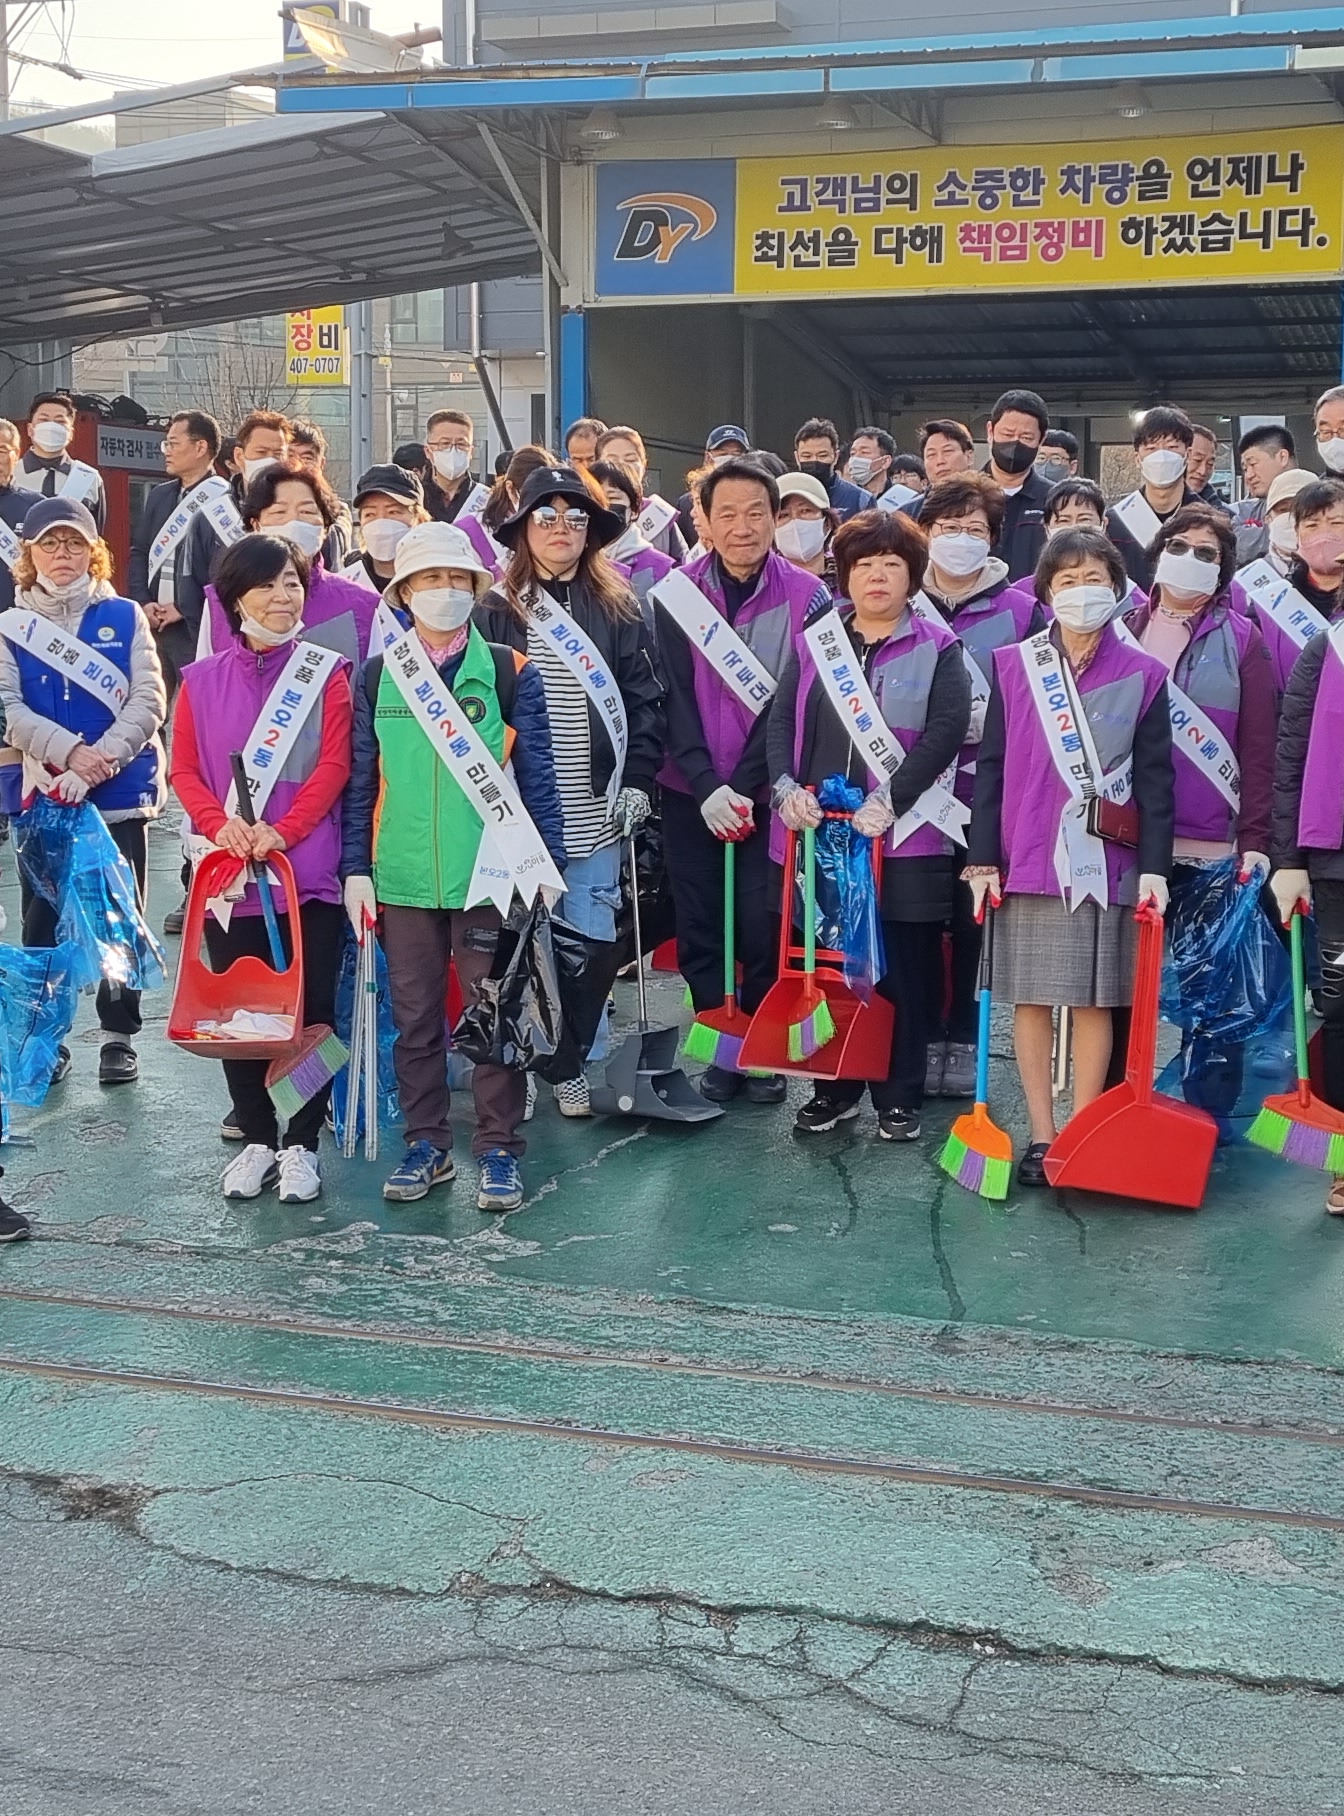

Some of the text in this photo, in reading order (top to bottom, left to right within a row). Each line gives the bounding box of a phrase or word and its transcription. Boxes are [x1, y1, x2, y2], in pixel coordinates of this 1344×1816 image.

[777, 152, 1306, 215] 고객님의 소중한 차량을 언제나
[615, 206, 690, 265] DY
[753, 206, 1329, 269] 최선을 다해 책임정비 하겠습니다.
[289, 357, 341, 374] 407-0707
[100, 436, 143, 459] 자동차검사
[46, 637, 81, 667] 명품
[294, 649, 326, 686] 명품
[550, 623, 608, 690] 본오2동
[817, 629, 842, 662] 명품
[831, 663, 874, 734] 본오2동
[252, 688, 304, 769] 본오2동
[393, 640, 422, 680] 명품
[414, 678, 473, 759] 본오2동
[465, 761, 515, 823] 만들기
[1041, 671, 1083, 754] 본오2동
